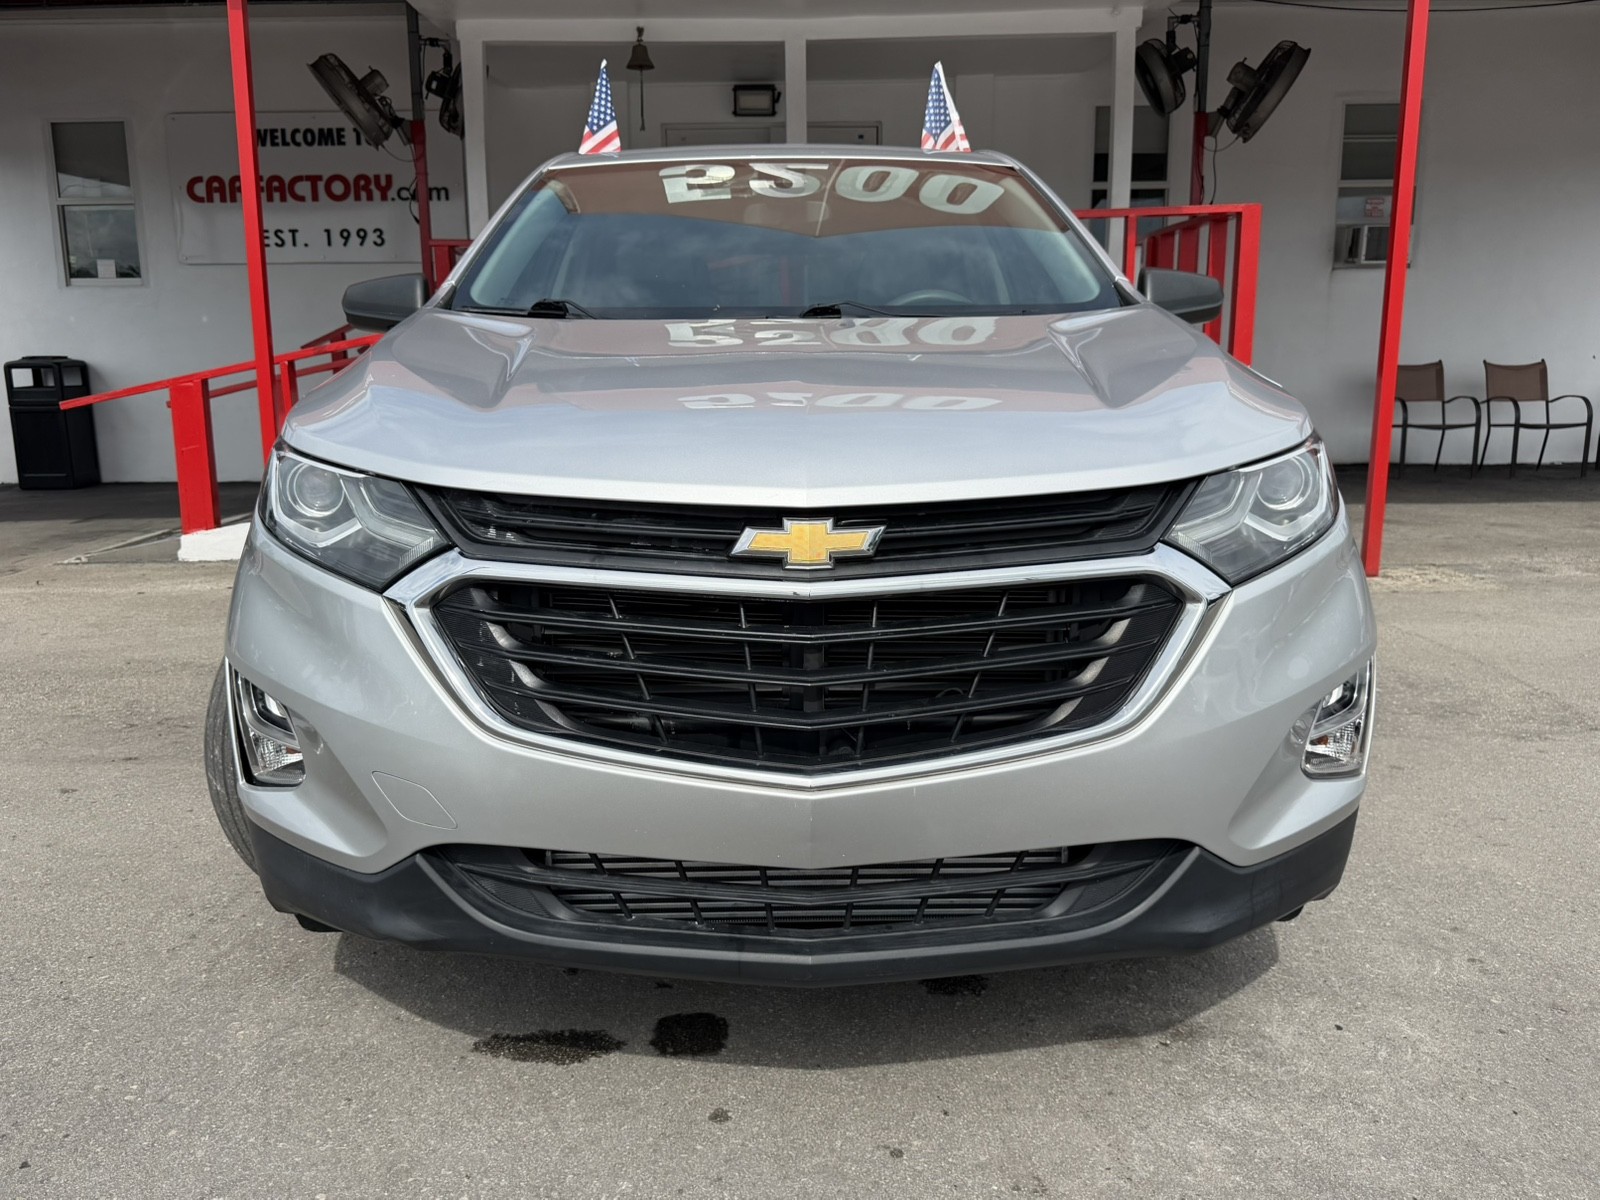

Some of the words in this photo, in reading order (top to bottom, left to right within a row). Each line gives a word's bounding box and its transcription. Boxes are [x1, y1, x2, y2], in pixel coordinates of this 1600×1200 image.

[256, 127, 346, 147] WELCOME
[352, 127, 372, 147] T
[323, 228, 386, 248] 1993
